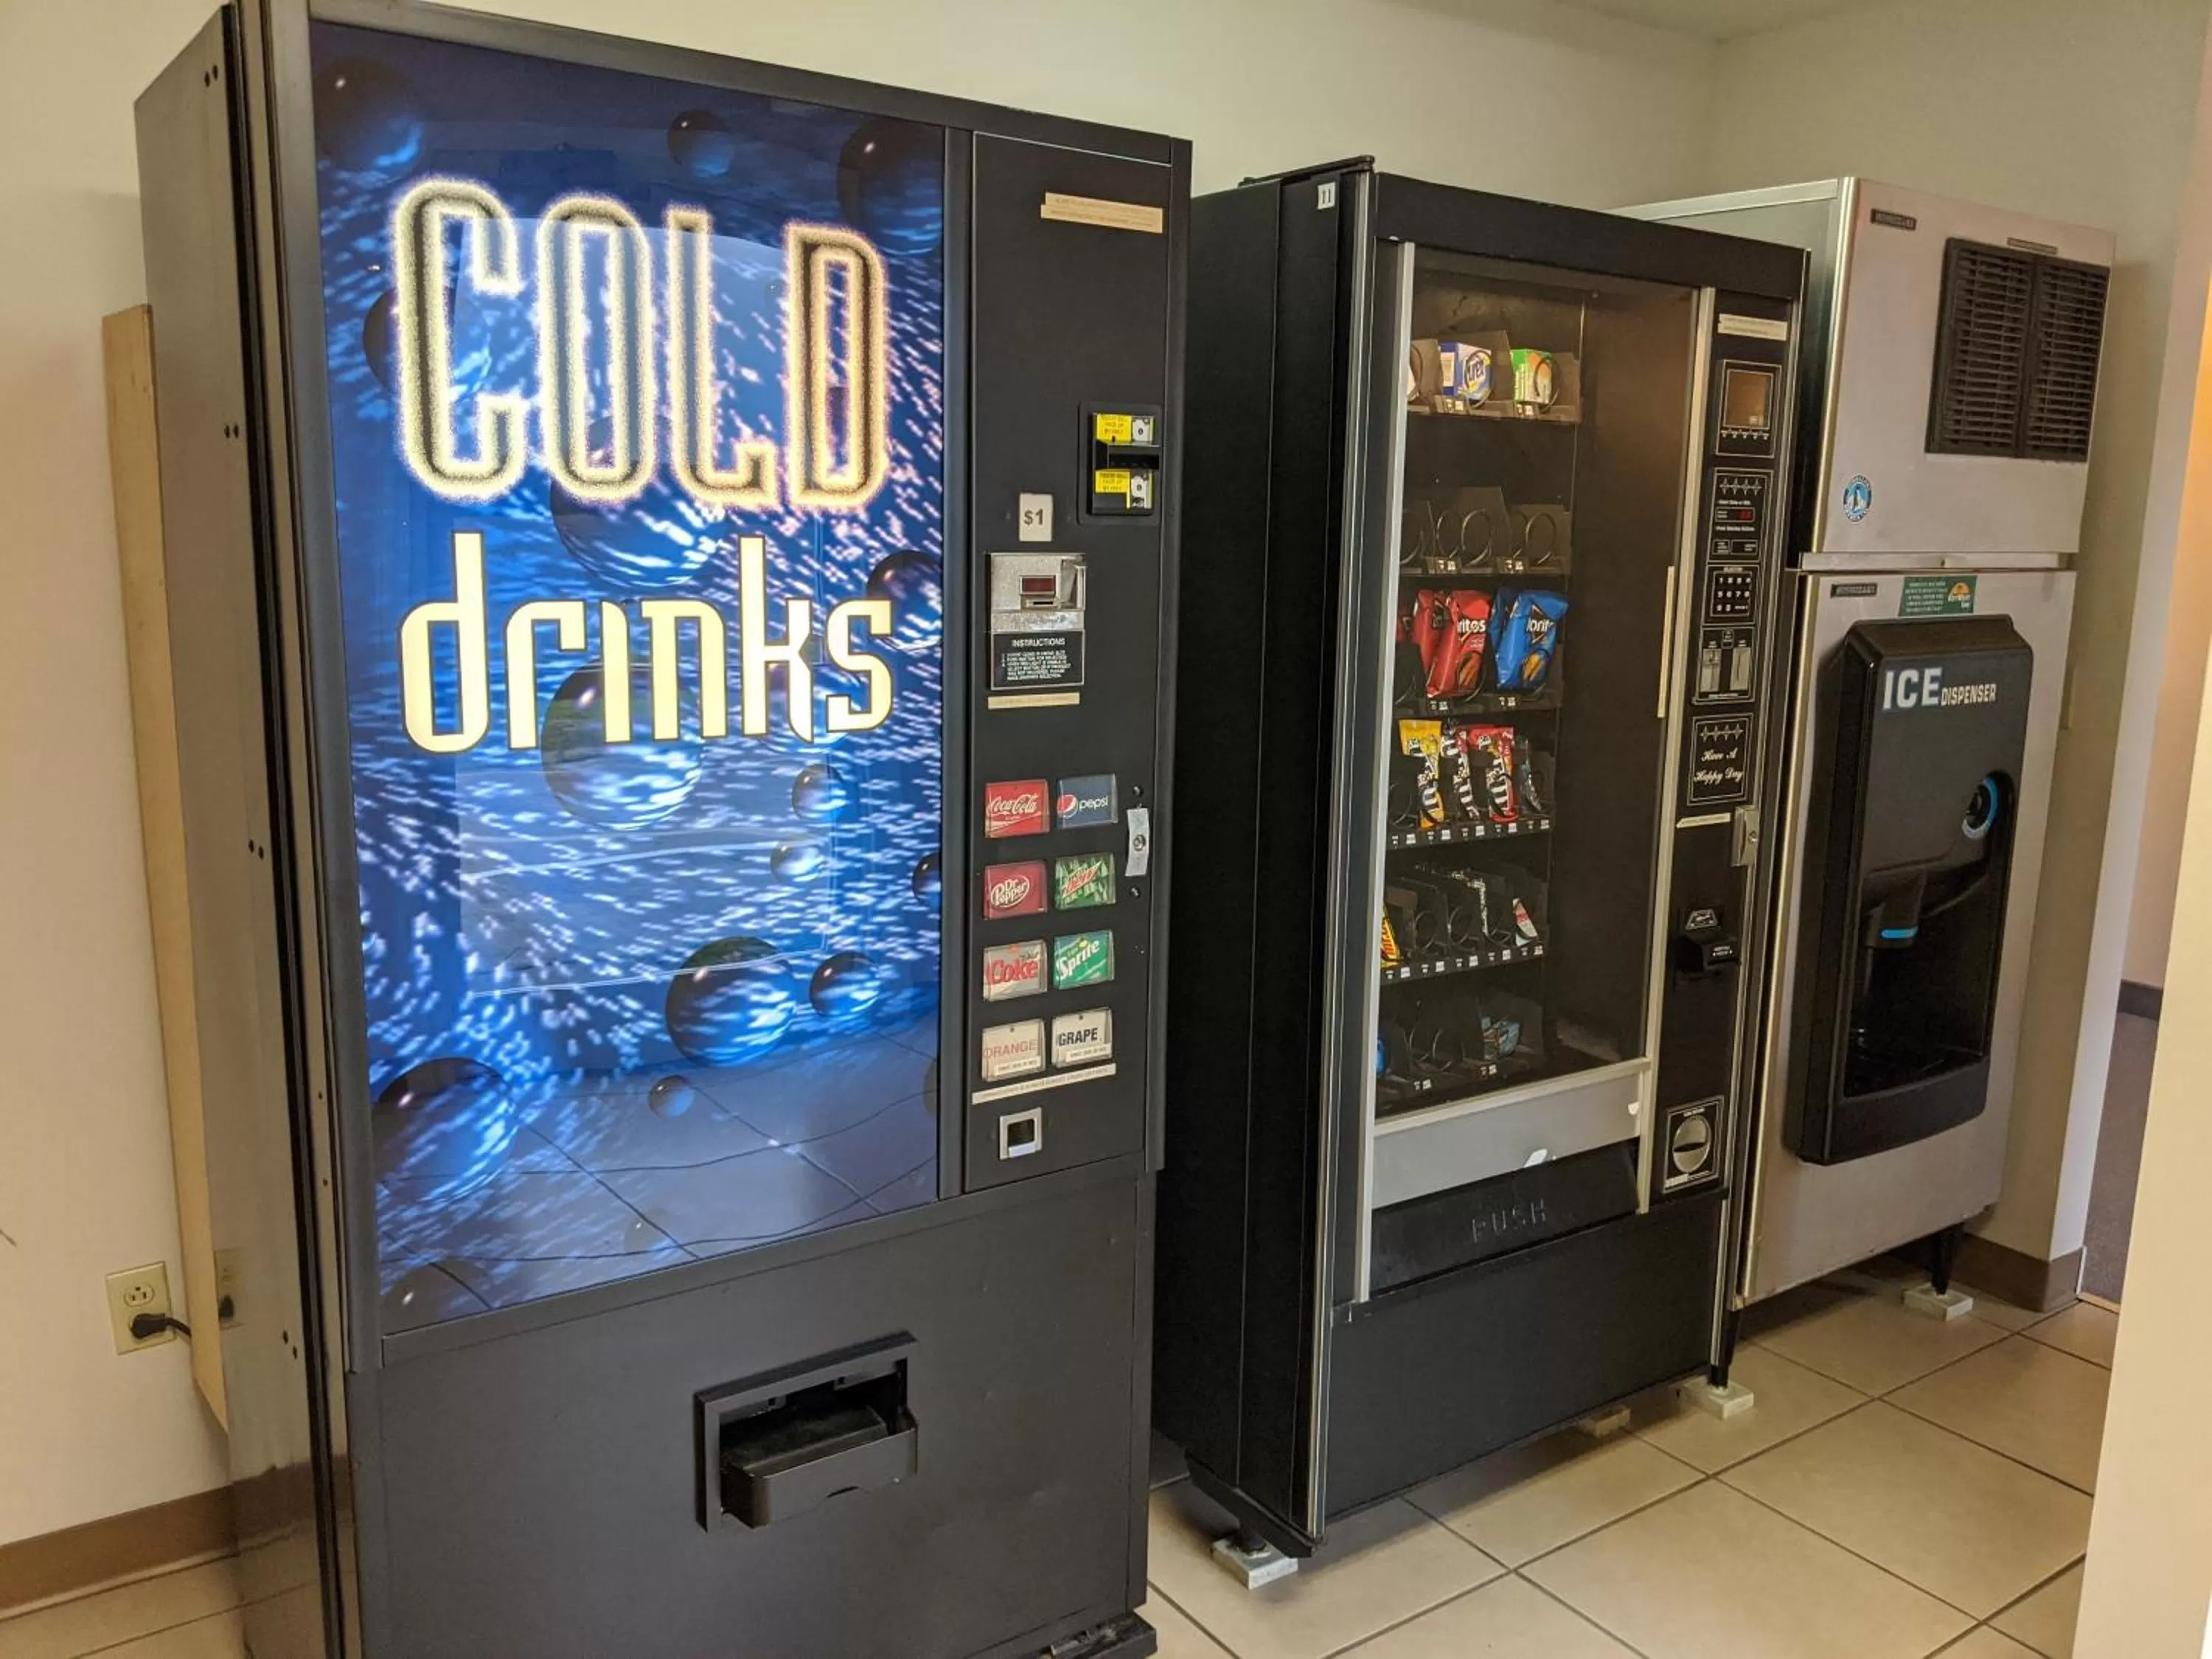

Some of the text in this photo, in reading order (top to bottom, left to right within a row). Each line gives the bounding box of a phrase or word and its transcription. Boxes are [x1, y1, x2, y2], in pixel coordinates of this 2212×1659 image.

[394, 178, 890, 510] COLD
[1023, 508, 1043, 526] $1
[1457, 618, 1486, 633] ritos
[400, 529, 893, 754] drinks
[1011, 637, 1065, 647] INSTRUCTIONS
[1882, 667, 1997, 711] ICE DISPENSER
[1694, 767, 1744, 785] Happy Day
[1079, 796, 1109, 811] pepsi
[992, 883, 1028, 906] Pepper
[1004, 879, 1018, 891] Dr
[1056, 939, 1100, 980] Sprite
[987, 958, 1039, 985] Coke
[1057, 1027, 1098, 1046] GRAPE
[984, 1040, 1037, 1058] ORANGE
[1471, 1197, 1546, 1243] PUSH
